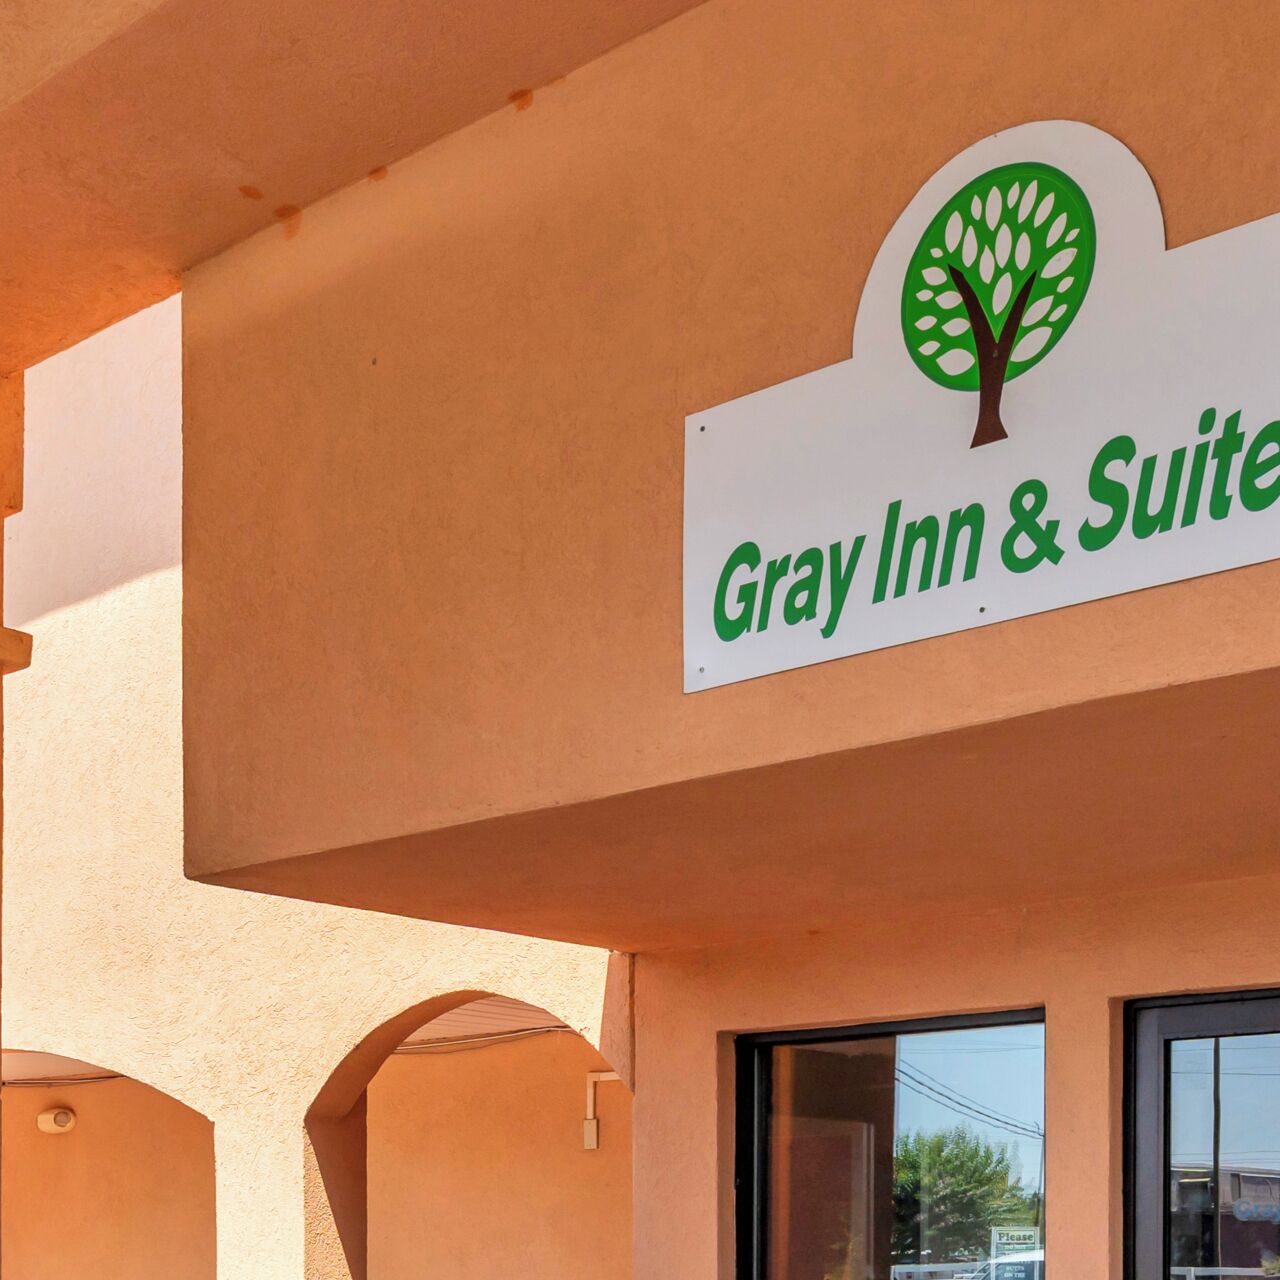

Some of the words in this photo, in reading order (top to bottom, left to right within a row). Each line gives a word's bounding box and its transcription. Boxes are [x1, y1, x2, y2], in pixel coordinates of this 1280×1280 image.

[713, 535, 866, 642] Gray
[872, 500, 986, 604] Inn
[1000, 479, 1065, 574] &
[997, 1231, 1035, 1242] Please
